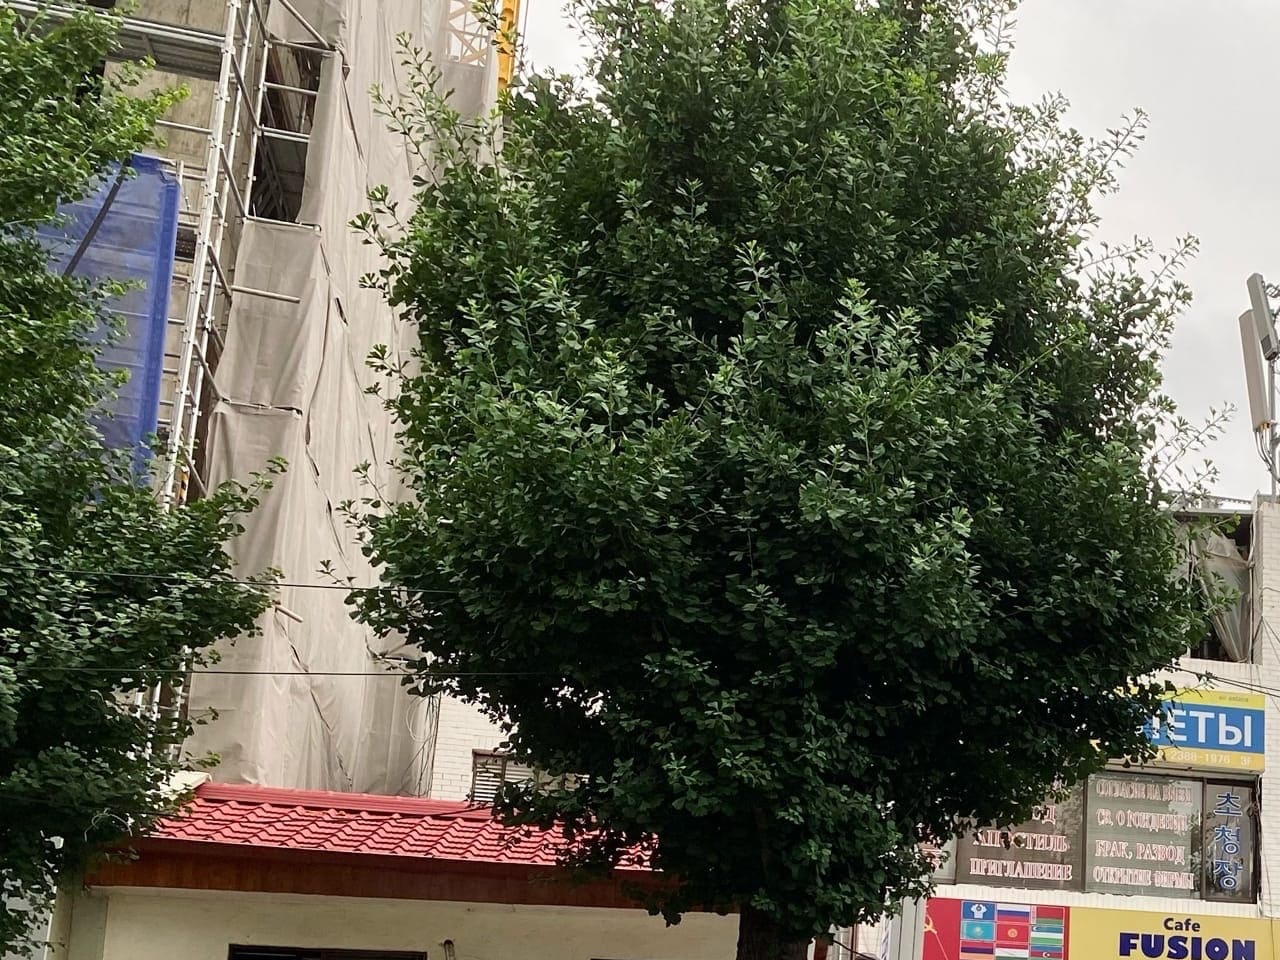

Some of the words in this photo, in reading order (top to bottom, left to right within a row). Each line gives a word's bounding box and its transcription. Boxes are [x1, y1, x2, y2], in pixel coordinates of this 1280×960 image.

[1213, 792, 1243, 890] 초청장
[1135, 842, 1186, 865] РАЗВОД
[969, 857, 1073, 881] ПРИГЛАШЕНИЕ
[1153, 870, 1195, 889] ФИРМЫ
[1163, 917, 1201, 932] Cafe
